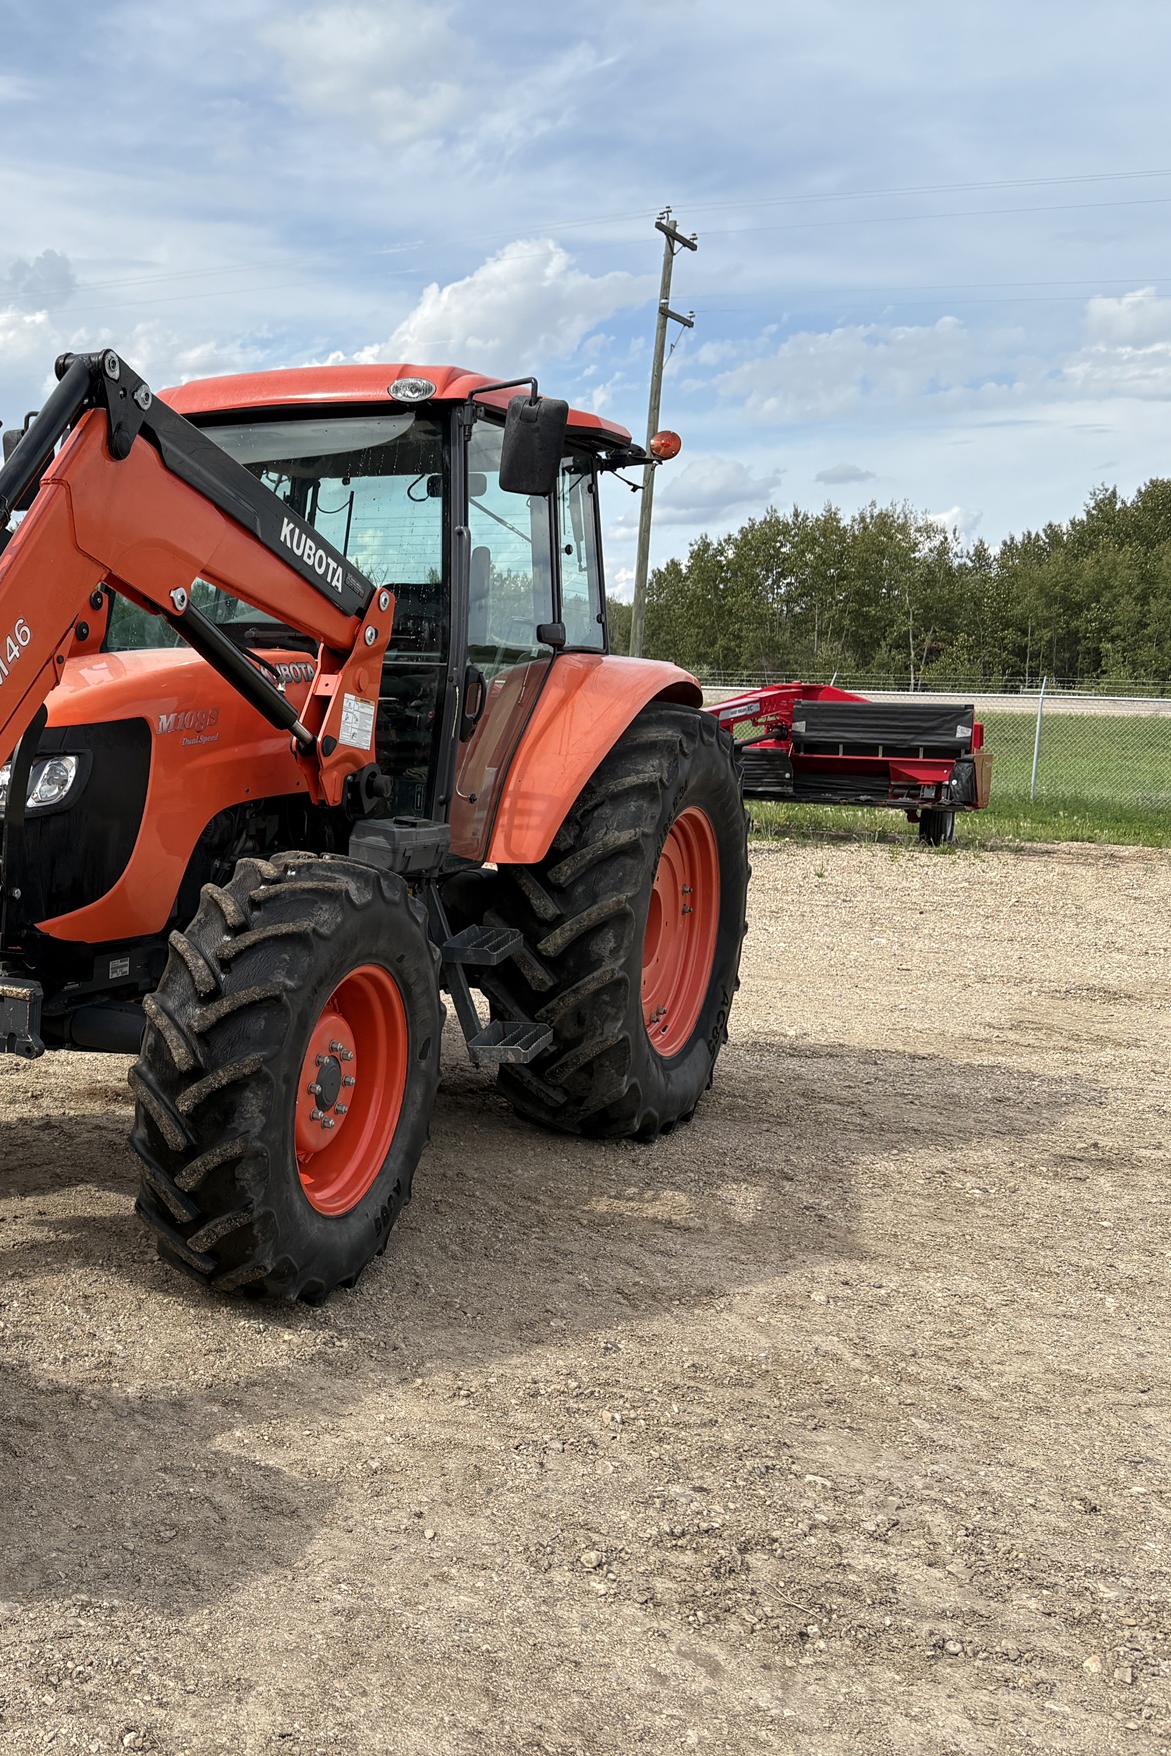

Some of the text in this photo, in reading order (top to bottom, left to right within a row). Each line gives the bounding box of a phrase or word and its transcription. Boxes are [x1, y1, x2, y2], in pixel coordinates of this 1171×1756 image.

[280, 517, 343, 594] KUBOTA
[156, 706, 220, 735] M108S
[181, 733, 220, 747] Dual Speed
